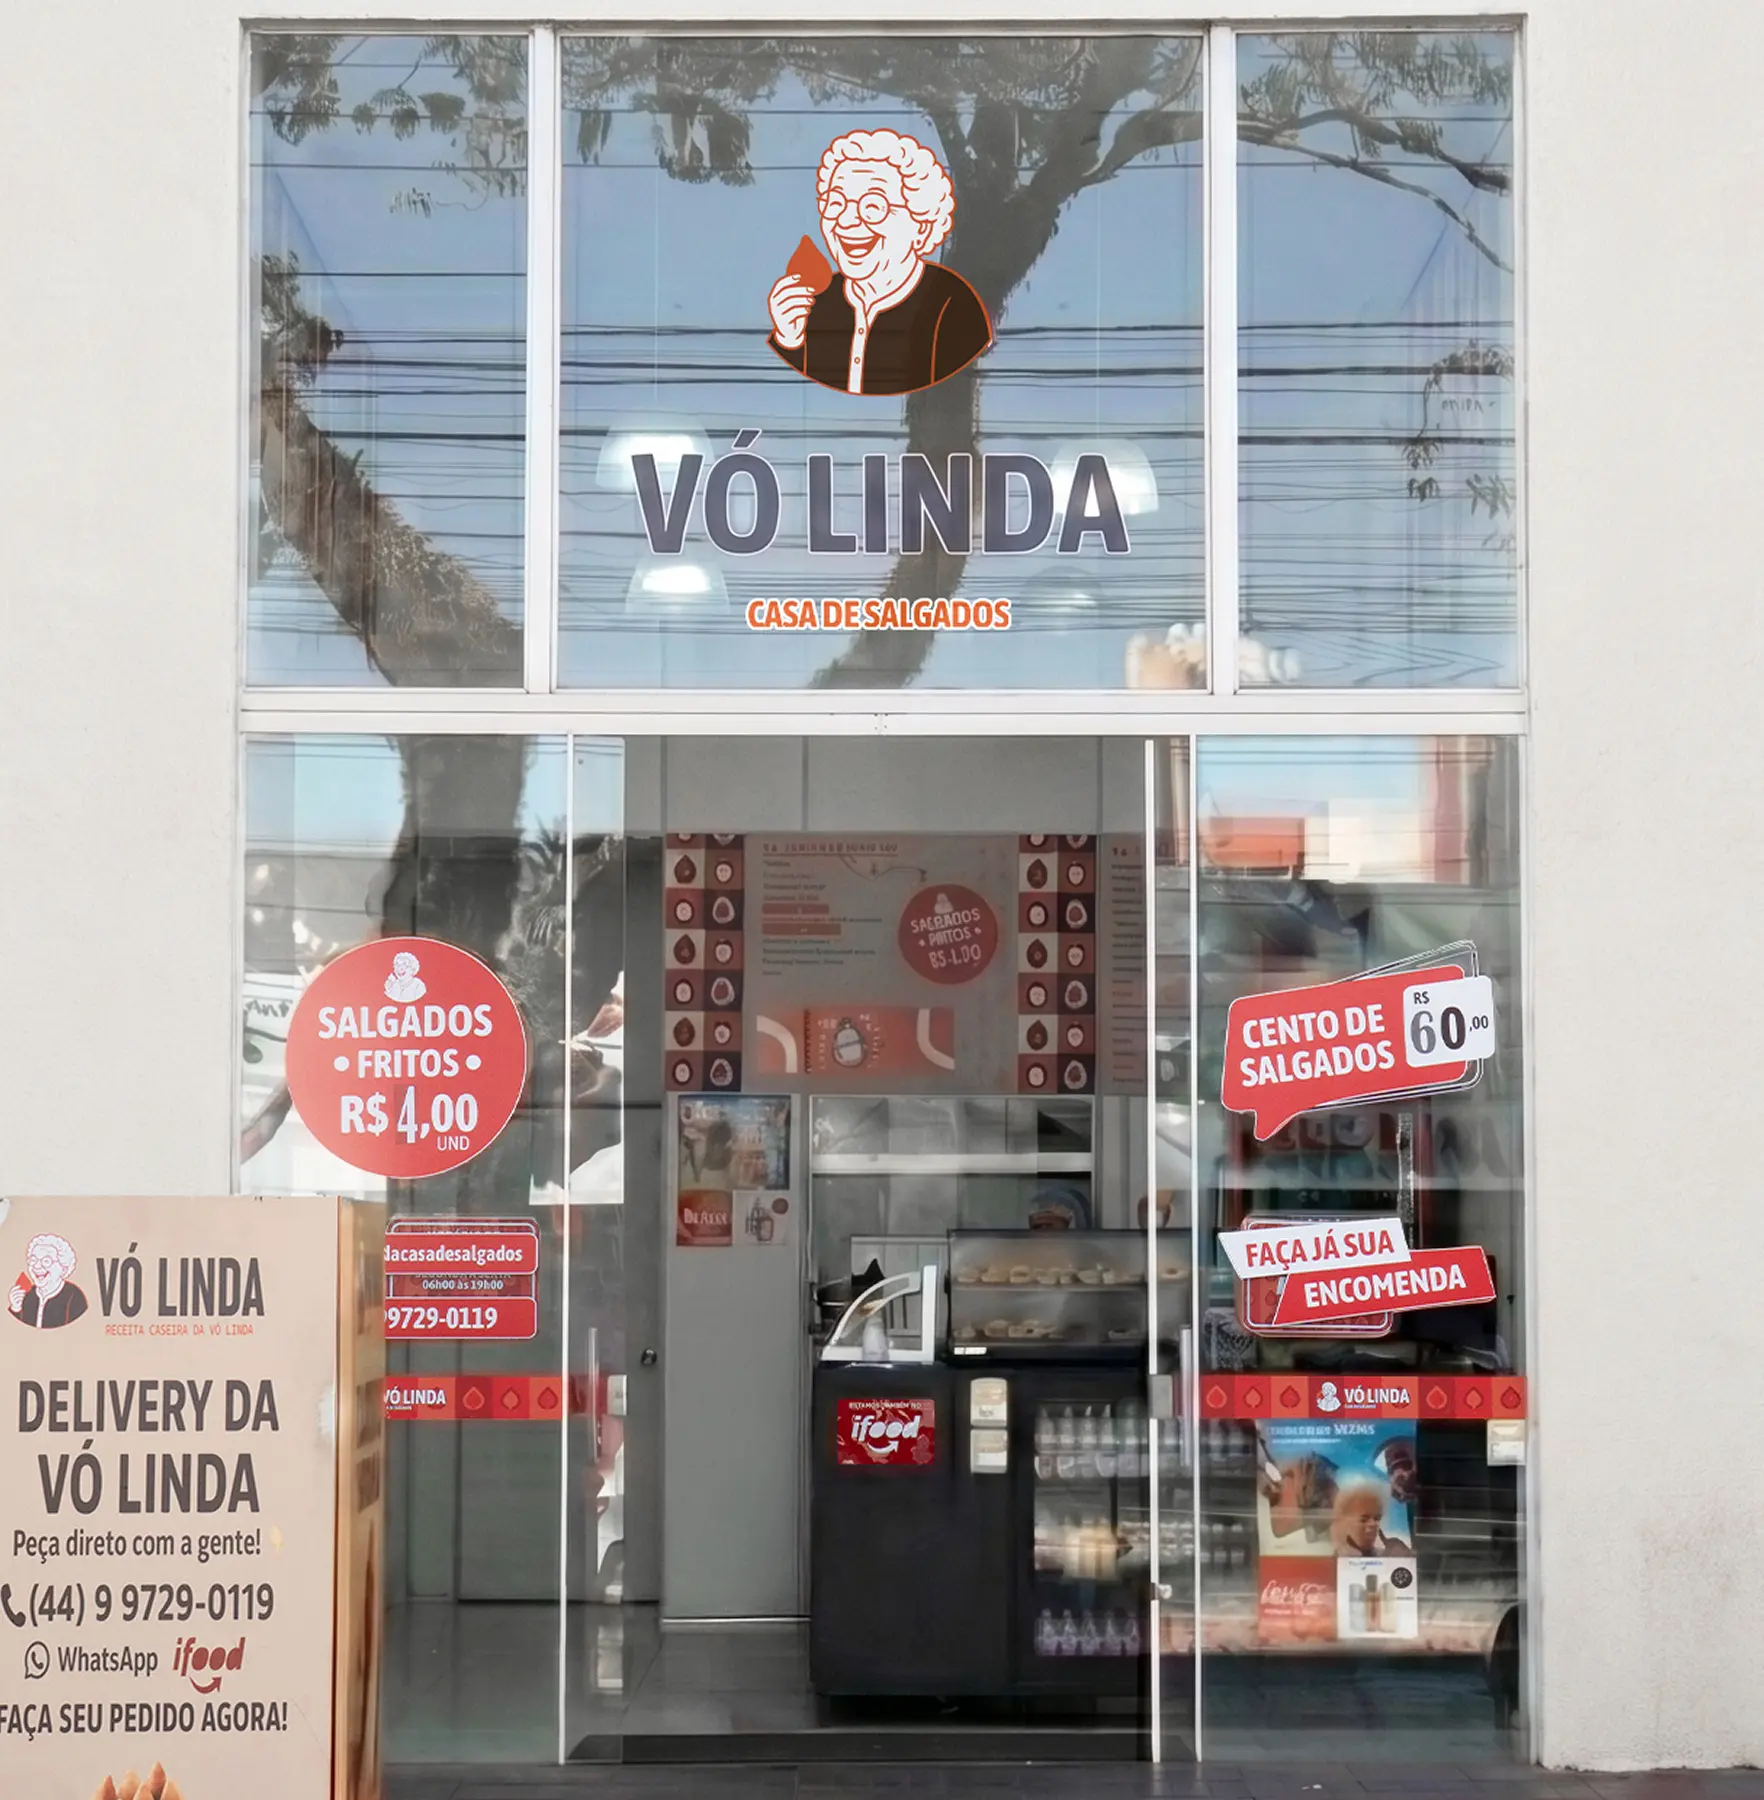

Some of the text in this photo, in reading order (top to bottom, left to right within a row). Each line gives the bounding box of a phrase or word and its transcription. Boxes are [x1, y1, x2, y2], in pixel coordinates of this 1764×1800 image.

[632, 429, 1130, 554] VÓ LINDA
[746, 598, 1010, 630] CASA DE SALGADOS
[318, 1004, 493, 1039] SALGADOS
[1242, 1003, 1385, 1049] CENTO DE
[358, 1049, 459, 1078] FRITOS
[1240, 1040, 1395, 1087] SALGADOS
[340, 1085, 479, 1144] R$ 4,00
[437, 1136, 470, 1151] UND
[1245, 1228, 1395, 1271] FAÇA JÁ SUA
[96, 1242, 265, 1318] VÓ LINDA
[422, 1279, 454, 1290] 06h00
[470, 1279, 503, 1290] 19h00
[1304, 1263, 1467, 1308] ENCOMENDA
[105, 1322, 253, 1336] RECEITA CASEIRA DA VÓ LINDA
[19, 1379, 279, 1432] DELIVERY DA
[403, 1389, 446, 1405] LINDA
[1343, 1384, 1410, 1403] VÓ LINDA
[38, 1439, 260, 1514] VÓ LINDA
[13, 1528, 261, 1564] Peça direto com a gente!
[29, 1582, 275, 1627] (44) 9 9729-0119
[57, 1646, 159, 1677] WhatsApp
[0, 1701, 288, 1742] FAÇA SEU PEDIDO AGORA!
